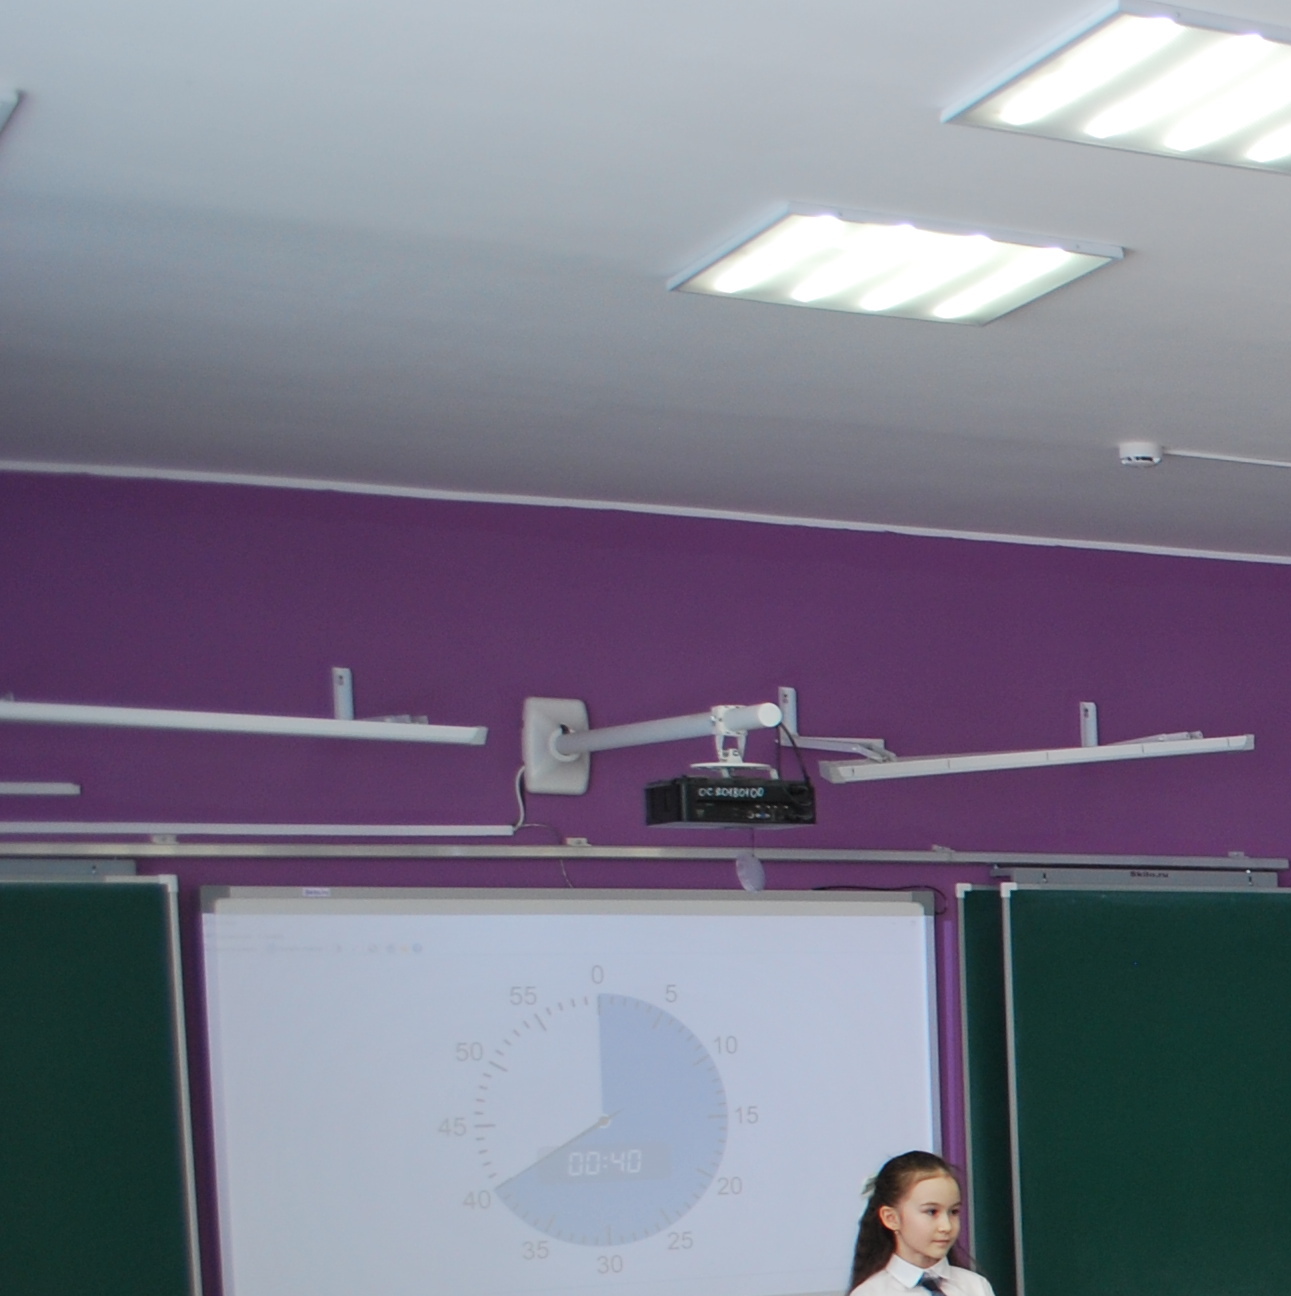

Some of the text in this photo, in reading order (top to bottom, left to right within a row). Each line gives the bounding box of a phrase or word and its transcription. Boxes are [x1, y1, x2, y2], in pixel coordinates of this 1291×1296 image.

[590, 964, 604, 985] 0
[509, 985, 537, 1006] 55
[665, 984, 678, 1003] 5
[455, 1042, 483, 1062] 50
[714, 1035, 738, 1055] 10
[735, 1105, 759, 1125] 15
[438, 1117, 467, 1137] 45
[568, 1149, 642, 1177] 00:40
[717, 1176, 743, 1196] 20
[462, 1189, 492, 1210] 40
[522, 1240, 550, 1261] 35
[667, 1231, 694, 1251] 25
[596, 1254, 623, 1275] 30
